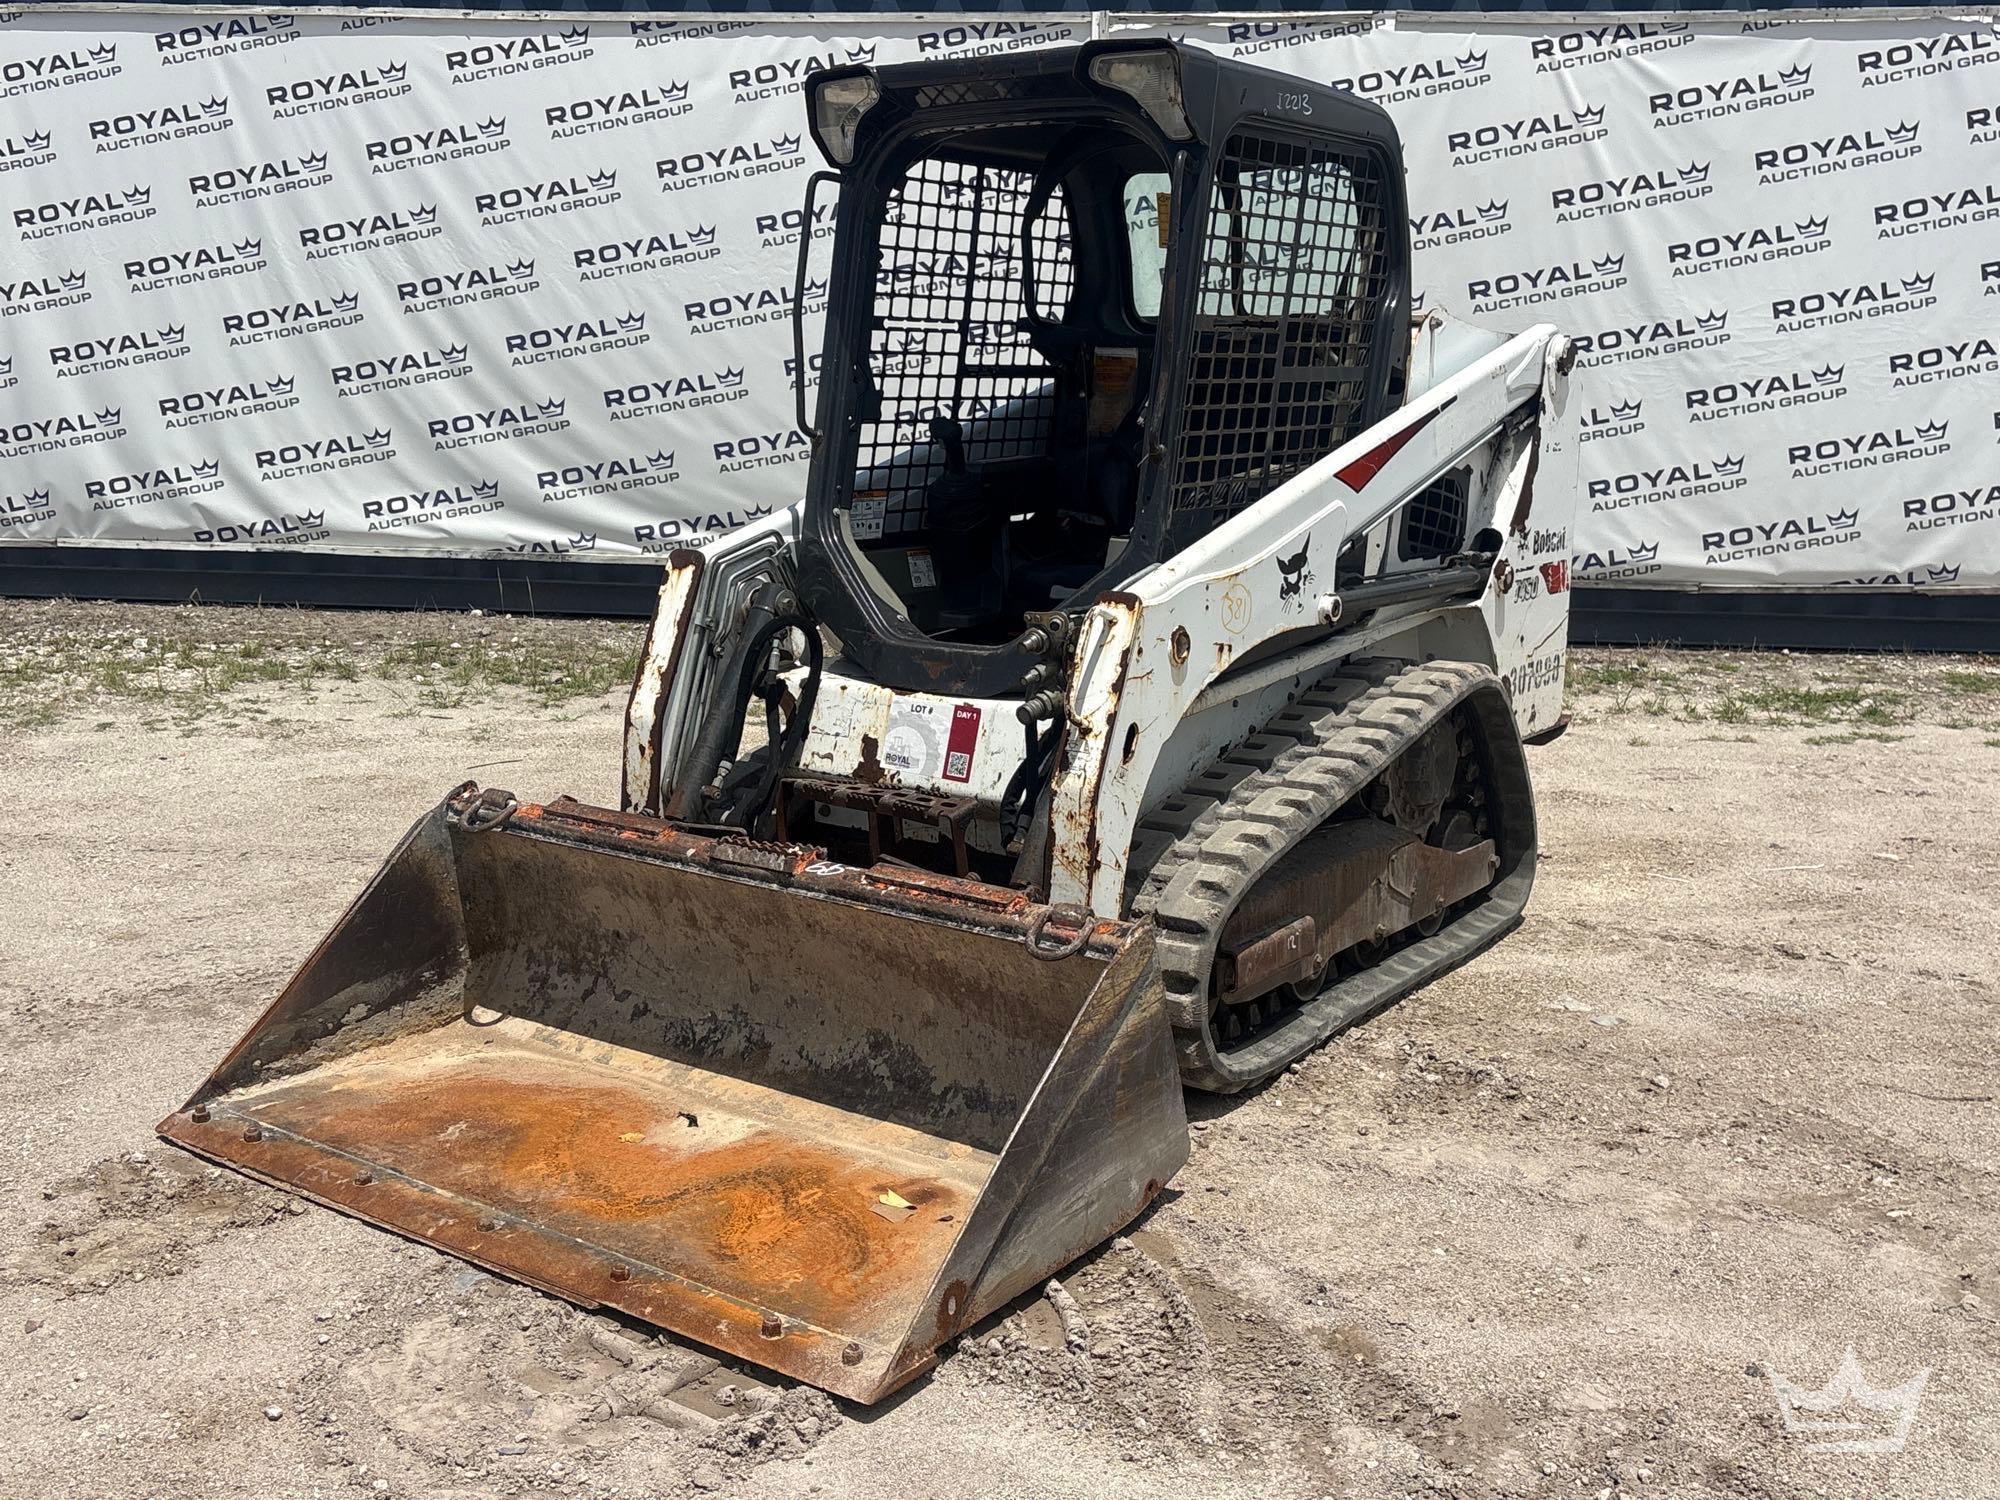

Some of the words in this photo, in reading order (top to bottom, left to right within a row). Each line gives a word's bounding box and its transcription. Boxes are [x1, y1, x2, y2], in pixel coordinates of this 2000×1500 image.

[154, 16, 268, 53] ROYAL
[161, 42, 238, 67] AUCTION
[240, 30, 302, 51] GROUP
[634, 24, 714, 50] AUCTION
[1006, 27, 1073, 51] GROUP
[1231, 31, 1316, 58] AUCTION
[1319, 18, 1386, 40] GROUP
[1530, 22, 1659, 60] ROYAL
[1857, 30, 1992, 73] ROYAL
[445, 34, 561, 71] ROYAL
[451, 61, 529, 85] AUCTION
[532, 48, 594, 69] GROUP
[1535, 48, 1622, 74] AUCTION
[1626, 33, 1695, 57] GROUP
[62, 65, 122, 86] GROUP
[266, 69, 380, 106] ROYAL
[728, 52, 847, 90] ROYAL
[1424, 74, 1491, 96] GROUP
[1861, 60, 1953, 88] AUCTION
[273, 96, 349, 120] AUCTION
[351, 84, 412, 105] GROUP
[545, 89, 661, 126] ROYAL
[1649, 74, 1779, 115] ROYAL
[1653, 102, 1741, 129] AUCTION
[1745, 88, 1815, 111] GROUP
[88, 104, 202, 140] ROYAL
[95, 130, 171, 154] AUCTION
[173, 118, 234, 139] GROUP
[551, 116, 629, 140] AUCTION
[631, 103, 694, 124] GROUP
[1447, 113, 1573, 153] ROYAL
[365, 125, 478, 161] ROYAL
[372, 151, 448, 175] AUCTION
[450, 139, 511, 159] GROUP
[656, 142, 773, 179] ROYAL
[1452, 141, 1537, 168] AUCTION
[1541, 128, 1609, 150] GROUP
[1754, 130, 1886, 171] ROYAL
[0, 152, 57, 172] GROUP
[188, 159, 301, 195] ROYAL
[662, 169, 740, 193] AUCTION
[743, 156, 806, 177] GROUP
[1758, 159, 1847, 186] AUCTION
[1851, 145, 1922, 168] GROUP
[195, 185, 271, 209] AUCTION
[273, 174, 333, 194] GROUP
[475, 177, 589, 214] ROYAL
[1551, 171, 1678, 209] ROYAL
[1556, 198, 1641, 224] AUCTION
[1644, 185, 1713, 207] GROUP
[1873, 184, 2000, 226] ROYAL
[13, 193, 125, 228] ROYAL
[20, 218, 95, 242] AUCTION
[97, 207, 157, 227] GROUP
[481, 203, 558, 228] AUCTION
[560, 192, 622, 212] GROUP
[1877, 213, 1968, 240] AUCTION
[299, 212, 410, 248] ROYAL
[305, 238, 380, 261] AUCTION
[383, 226, 443, 246] GROUP
[1444, 223, 1512, 245] GROUP
[1667, 225, 1795, 264] ROYAL
[123, 245, 236, 280] ROYAL
[573, 233, 688, 269] ROYAL
[579, 259, 657, 282] AUCTION
[659, 247, 721, 267] GROUP
[1672, 252, 1758, 278] AUCTION
[1762, 239, 1832, 261] GROUP
[131, 271, 206, 294] AUCTION
[207, 259, 268, 279] GROUP
[396, 266, 508, 302] ROYAL
[1468, 262, 1593, 301] ROYAL
[33, 292, 92, 311] GROUP
[403, 292, 478, 315] AUCTION
[480, 280, 540, 300] GROUP
[684, 286, 796, 322] ROYAL
[1472, 289, 1557, 315] AUCTION
[1560, 277, 1628, 298] GROUP
[1771, 281, 1901, 320] ROYAL
[222, 299, 333, 334] ROYAL
[229, 324, 304, 348] AUCTION
[305, 313, 364, 333] GROUP
[690, 312, 768, 336] AUCTION
[1775, 309, 1863, 335] AUCTION
[1867, 296, 1937, 318] GROUP
[49, 331, 160, 365] ROYAL
[505, 319, 618, 354] ROYAL
[511, 344, 587, 367] AUCTION
[589, 333, 650, 353] GROUP
[1570, 318, 1696, 354] ROYAL
[1575, 345, 1659, 370] AUCTION
[1663, 333, 1731, 354] GROUP
[56, 356, 130, 379] AUCTION
[132, 346, 191, 365] GROUP
[331, 351, 442, 385] ROYAL
[1892, 363, 1981, 389] AUCTION
[338, 376, 411, 398] AUCTION
[413, 365, 473, 384] GROUP
[603, 374, 717, 409] ROYAL
[1685, 372, 1812, 410] ROYAL
[158, 383, 268, 417] ROYAL
[165, 407, 239, 430] AUCTION
[241, 397, 300, 416] GROUP
[609, 399, 686, 422] AUCTION
[688, 389, 749, 408] GROUP
[1689, 399, 1775, 424] AUCTION
[1779, 387, 1847, 408] GROUP
[0, 414, 97, 445] ROYAL
[69, 428, 127, 447] GROUP
[427, 405, 539, 438] ROYAL
[434, 429, 510, 452] AUCTION
[512, 419, 571, 438] GROUP
[1579, 422, 1646, 443] GROUP
[255, 435, 366, 469] ROYAL
[719, 452, 795, 474] AUCTION
[1788, 429, 1915, 465] ROYAL
[1791, 455, 1878, 479] AUCTION
[1881, 443, 1951, 464] GROUP
[84, 466, 193, 499] ROYAL
[261, 460, 336, 482] AUCTION
[338, 449, 397, 468] GROUP
[536, 457, 648, 490] ROYAL
[1588, 463, 1713, 499] ROYAL
[93, 490, 165, 512] AUCTION
[166, 480, 225, 499] GROUP
[362, 486, 474, 519] ROYAL
[542, 481, 618, 503] AUCTION
[620, 472, 680, 490] GROUP
[1592, 489, 1676, 513] AUCTION
[1680, 477, 1747, 498] GROUP
[0, 509, 58, 528] GROUP
[367, 511, 443, 533] AUCTION
[445, 500, 505, 518] GROUP
[633, 511, 746, 543] ROYAL
[1702, 516, 1827, 552] ROYAL
[1906, 508, 1994, 533] AUCTION
[1706, 542, 1790, 565] AUCTION
[1793, 531, 1862, 550] GROUP
[910, 703, 927, 715] LOT
[956, 710, 972, 720] DAY
[972, 712, 977, 721] 1
[885, 752, 911, 765] ROYAL
